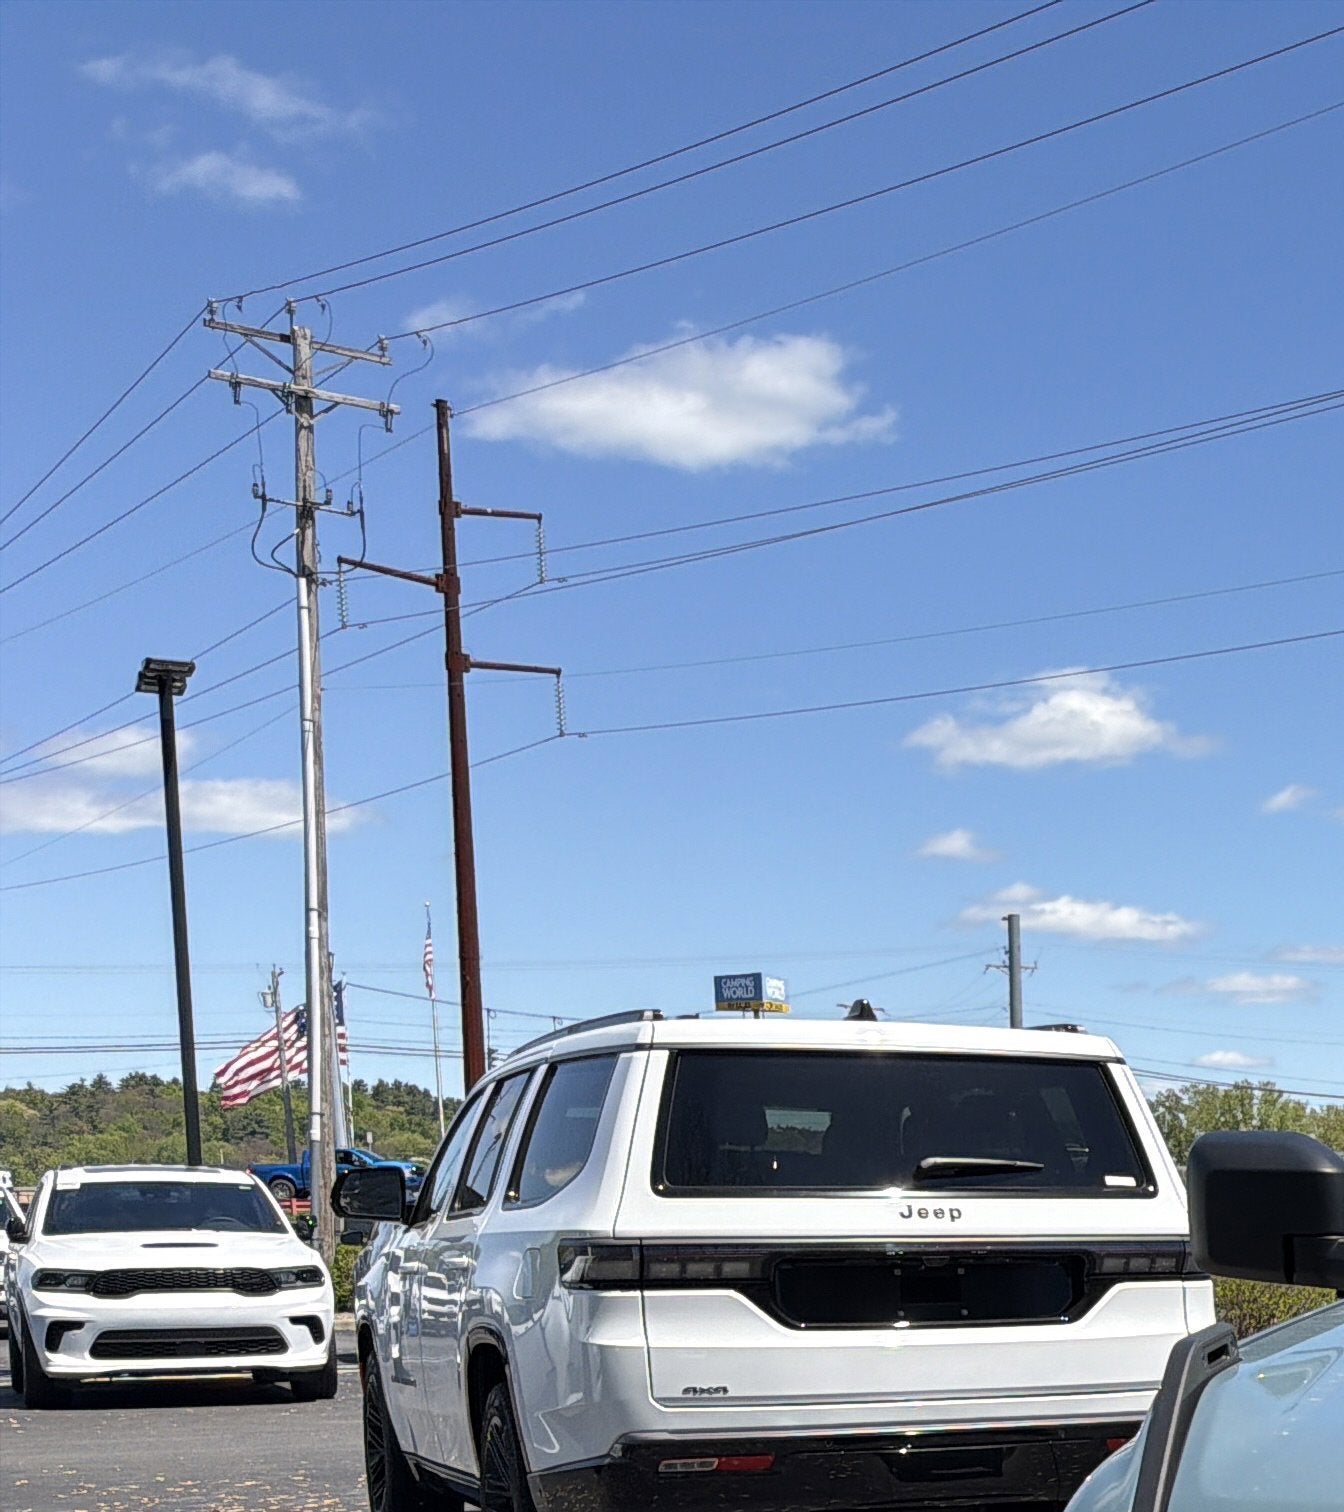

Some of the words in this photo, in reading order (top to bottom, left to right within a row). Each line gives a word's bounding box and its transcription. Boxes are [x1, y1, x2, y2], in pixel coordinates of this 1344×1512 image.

[721, 976, 755, 988] CAMPING
[722, 986, 755, 999] WORLD
[899, 1204, 962, 1222] Jeep
